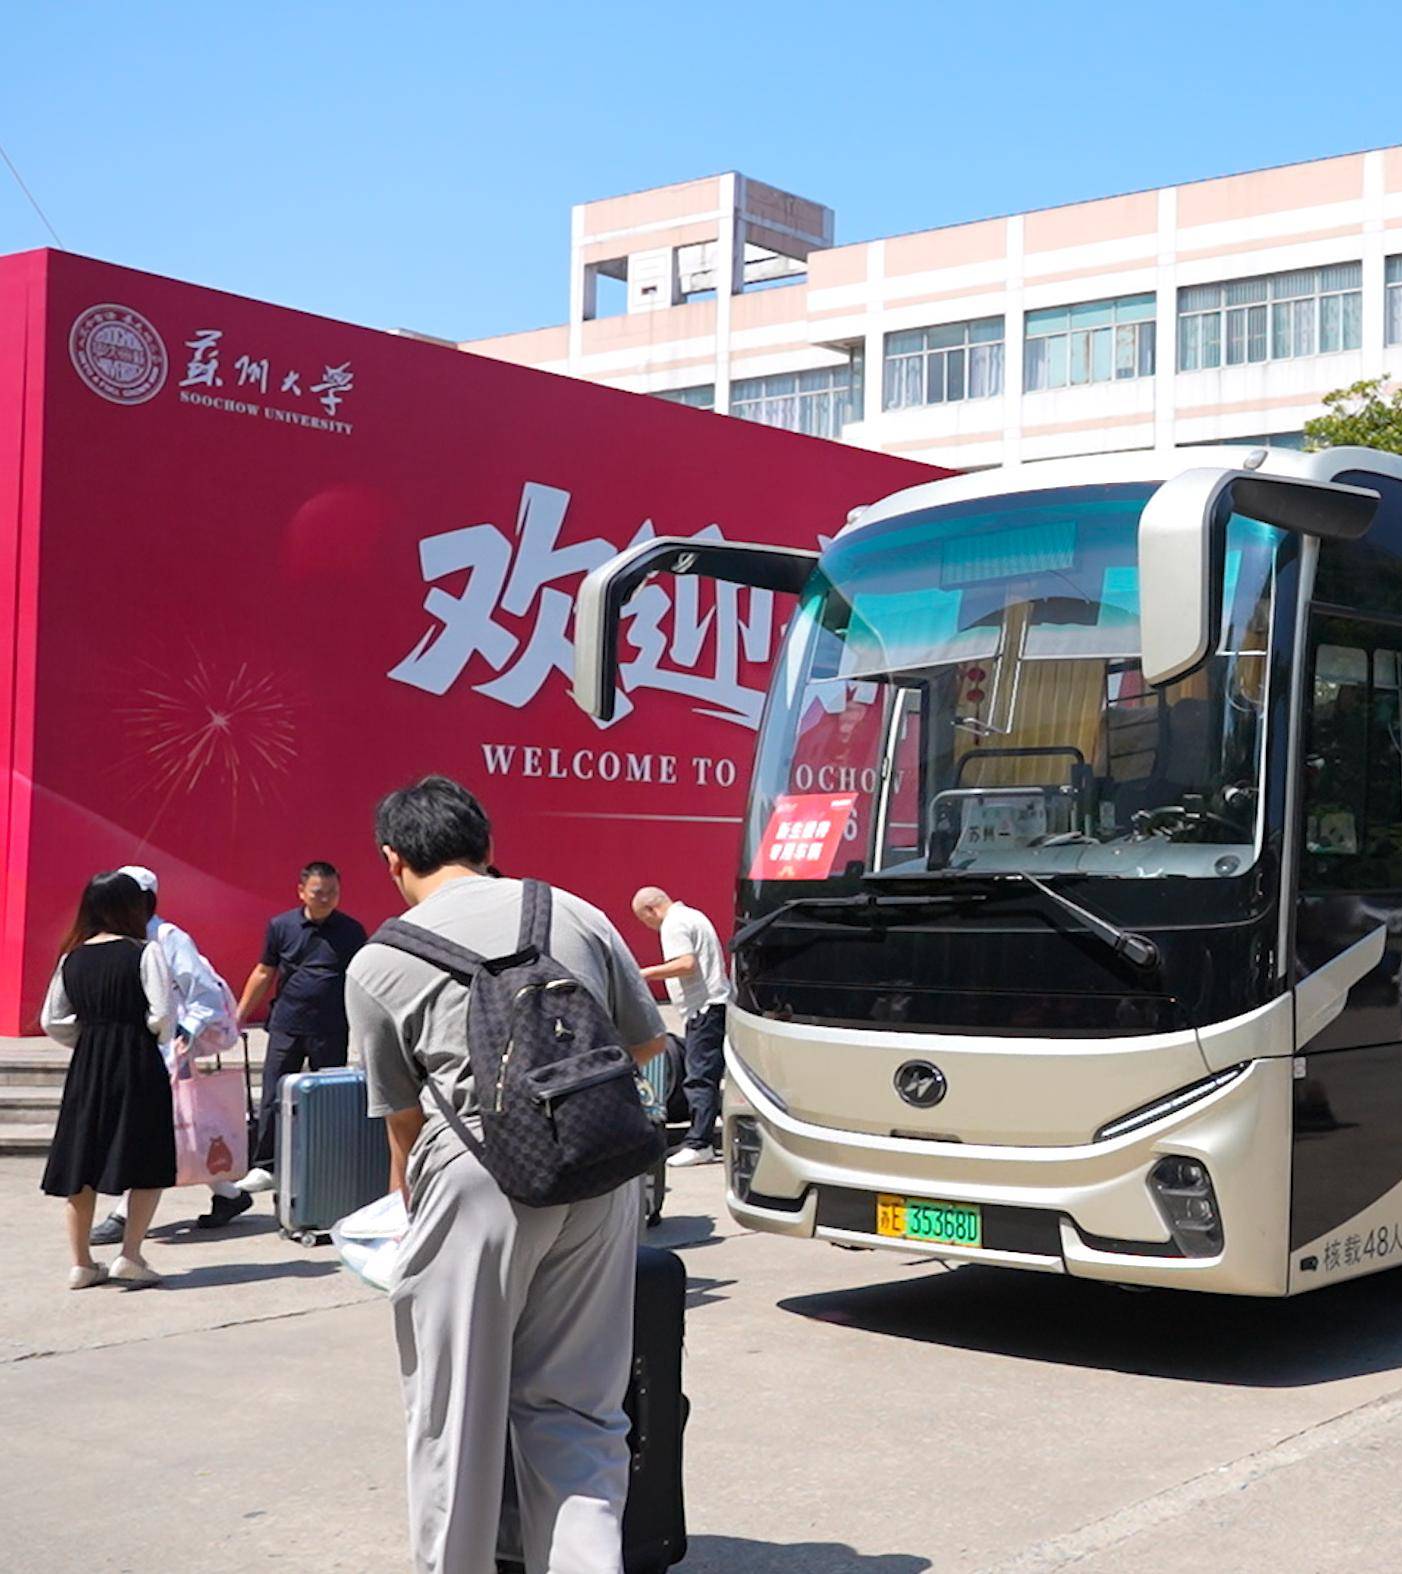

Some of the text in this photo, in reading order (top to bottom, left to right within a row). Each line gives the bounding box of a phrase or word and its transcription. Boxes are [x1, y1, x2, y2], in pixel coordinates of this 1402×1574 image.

[179, 391, 353, 435] SOOCHOW UNIVERSITY
[481, 743, 678, 785] WELCOME
[693, 757, 737, 788] TO
